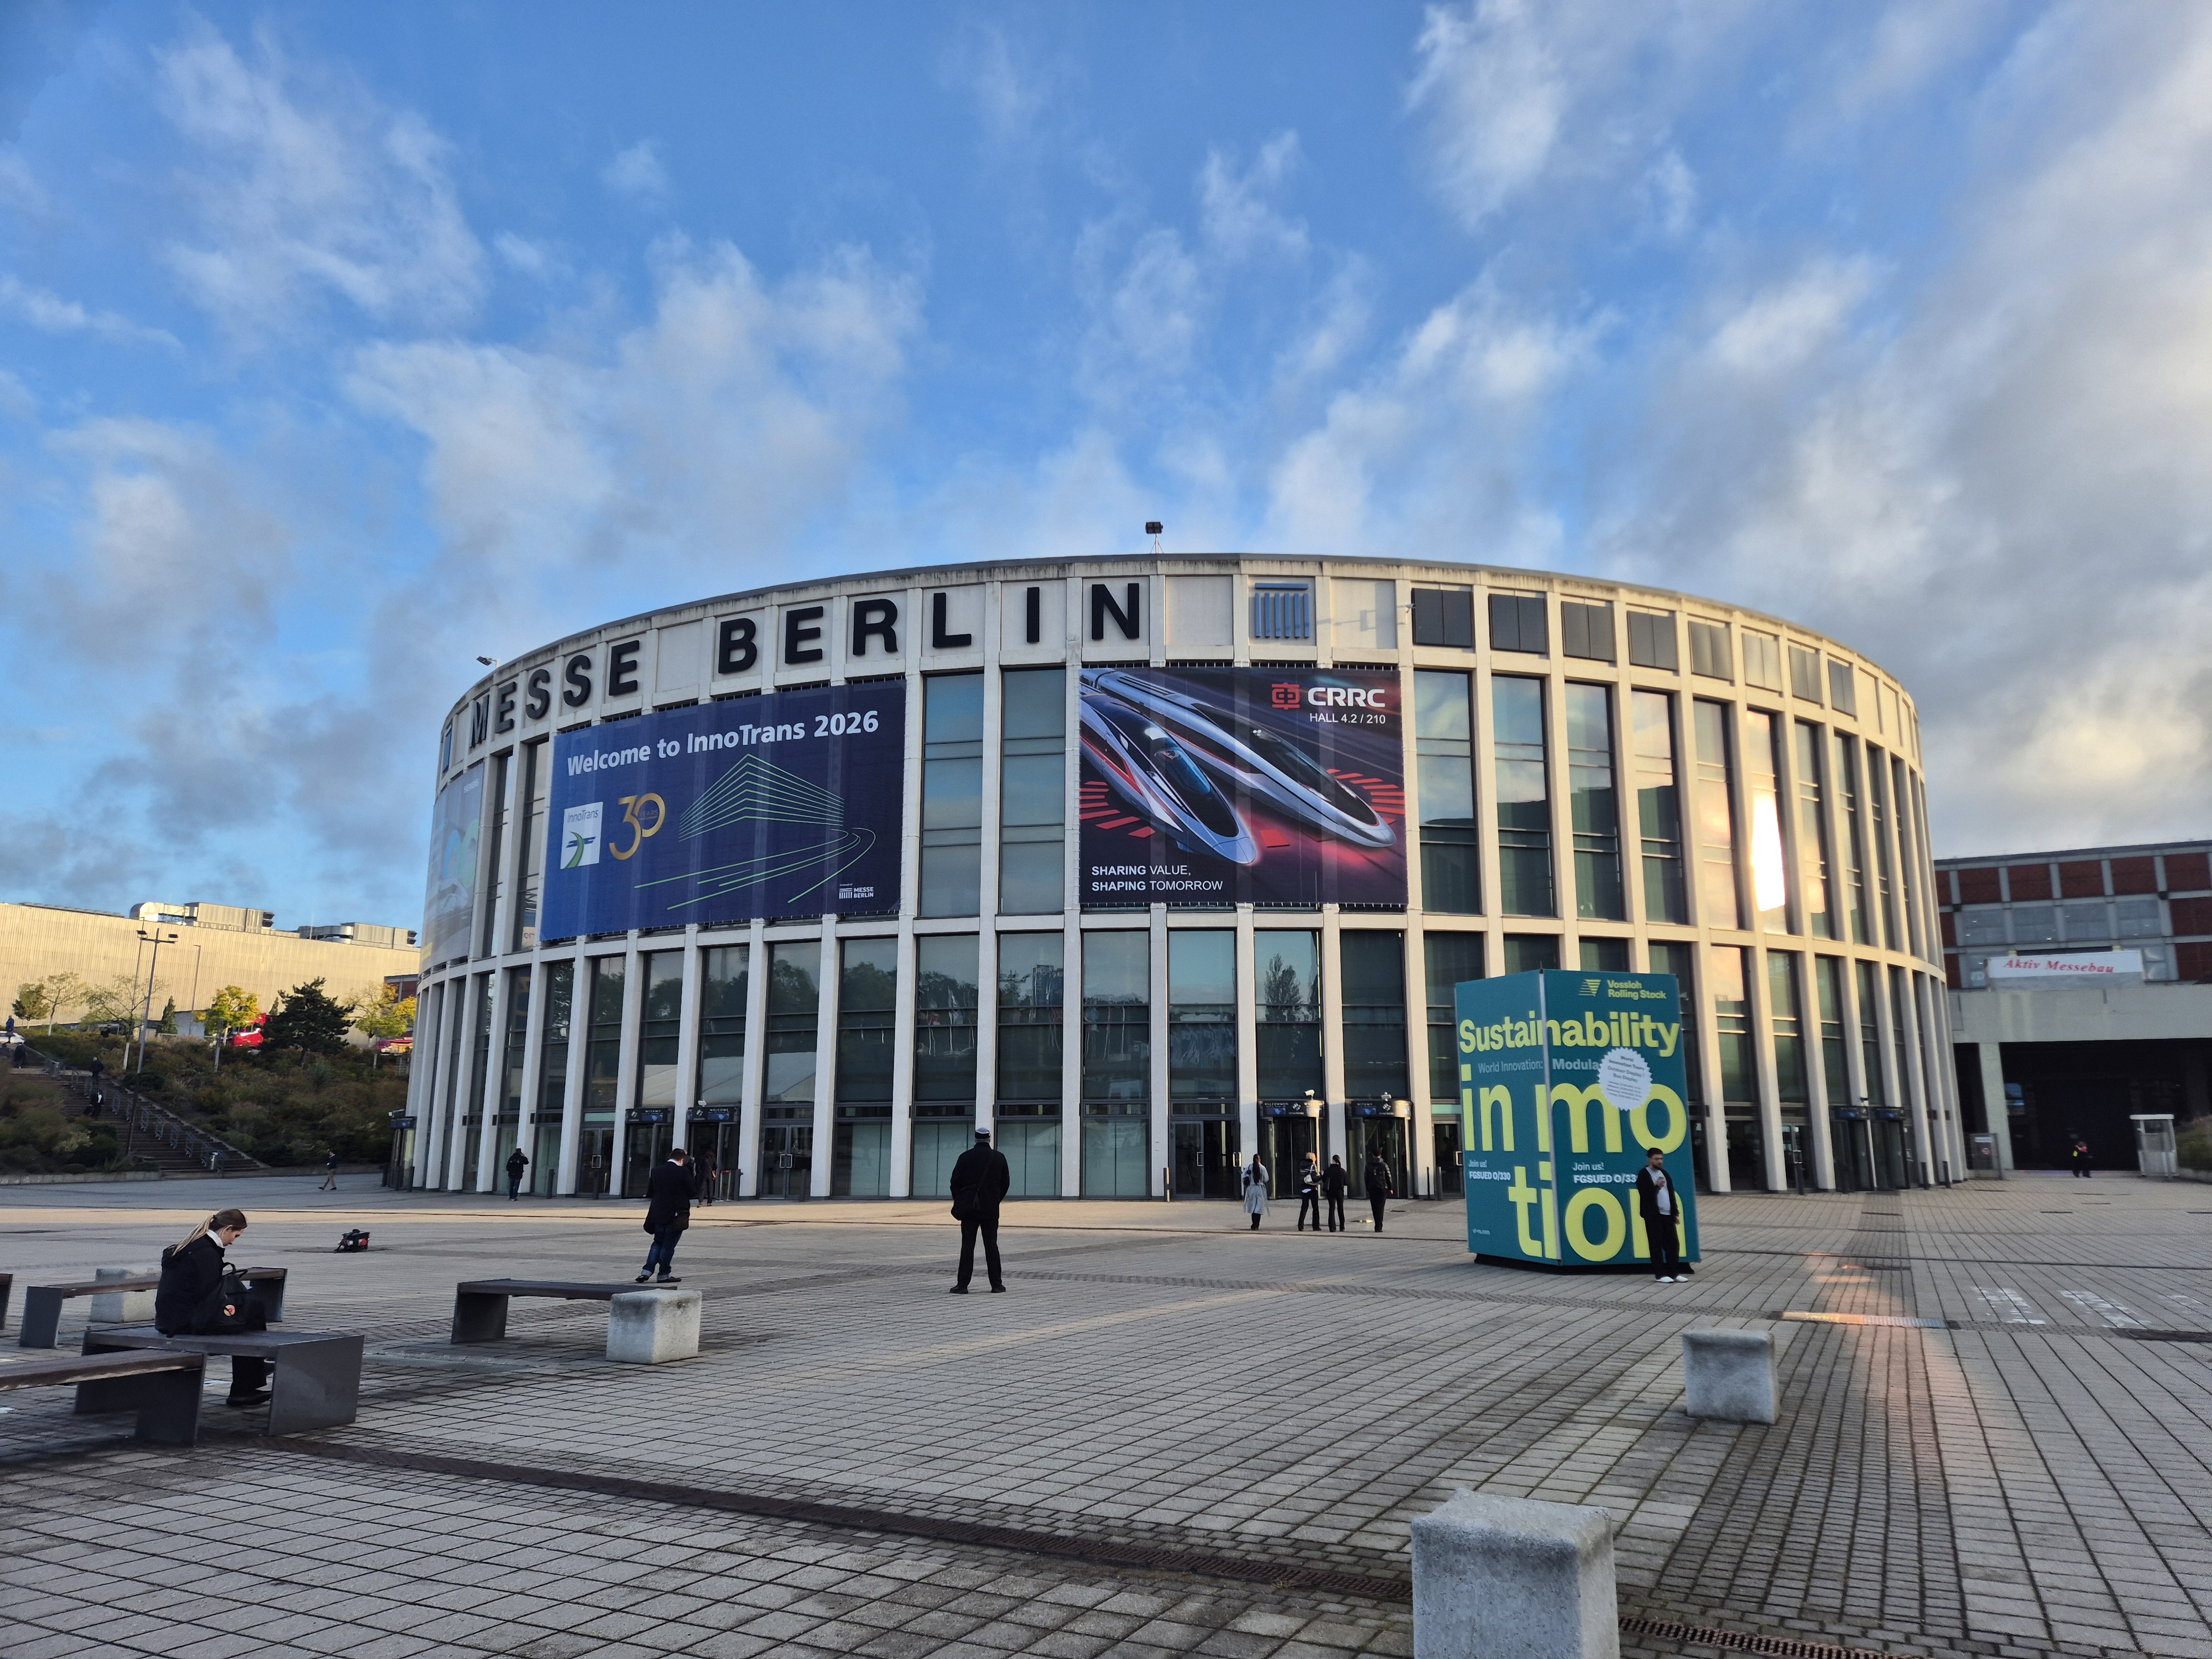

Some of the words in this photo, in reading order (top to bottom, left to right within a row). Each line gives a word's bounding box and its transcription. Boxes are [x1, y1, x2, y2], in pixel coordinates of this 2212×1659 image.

[469, 640, 639, 749] MESSE
[718, 583, 1140, 674] BERLIN
[1308, 687, 1385, 707] CRRC
[1310, 713, 1338, 722] HALL
[1340, 714, 1357, 723] 4.2
[1360, 714, 1364, 723] /
[1366, 714, 1386, 724] 210
[567, 744, 650, 776] Welcome
[657, 738, 680, 759] to
[687, 722, 805, 754] InnoTrans
[813, 710, 879, 738] 2026
[567, 809, 599, 823] InnoTrans
[609, 792, 666, 860] 30
[1092, 865, 1146, 875] SHARING
[1150, 865, 1191, 876] VALUE,
[1092, 881, 1146, 891] SHAPING
[1149, 880, 1223, 890] TOMORROW
[2004, 959, 2041, 969] Aktiv
[2044, 961, 2114, 973] Messebau
[1607, 979, 1642, 989] Vossloh
[1608, 989, 1639, 1000] Rolling
[1640, 990, 1667, 999] Stock
[1459, 1010, 1680, 1057] Sustainability
[1478, 1061, 1499, 1073] World
[1501, 1059, 1543, 1072] Innovation:
[1552, 1058, 1601, 1070] Modula
[1460, 1064, 1514, 1151] in
[1572, 1162, 1590, 1171] Join
[1469, 1171, 1492, 1180] FGSUED
[1573, 1175, 1612, 1183] FGSUED
[1614, 1173, 1638, 1183] O/33
